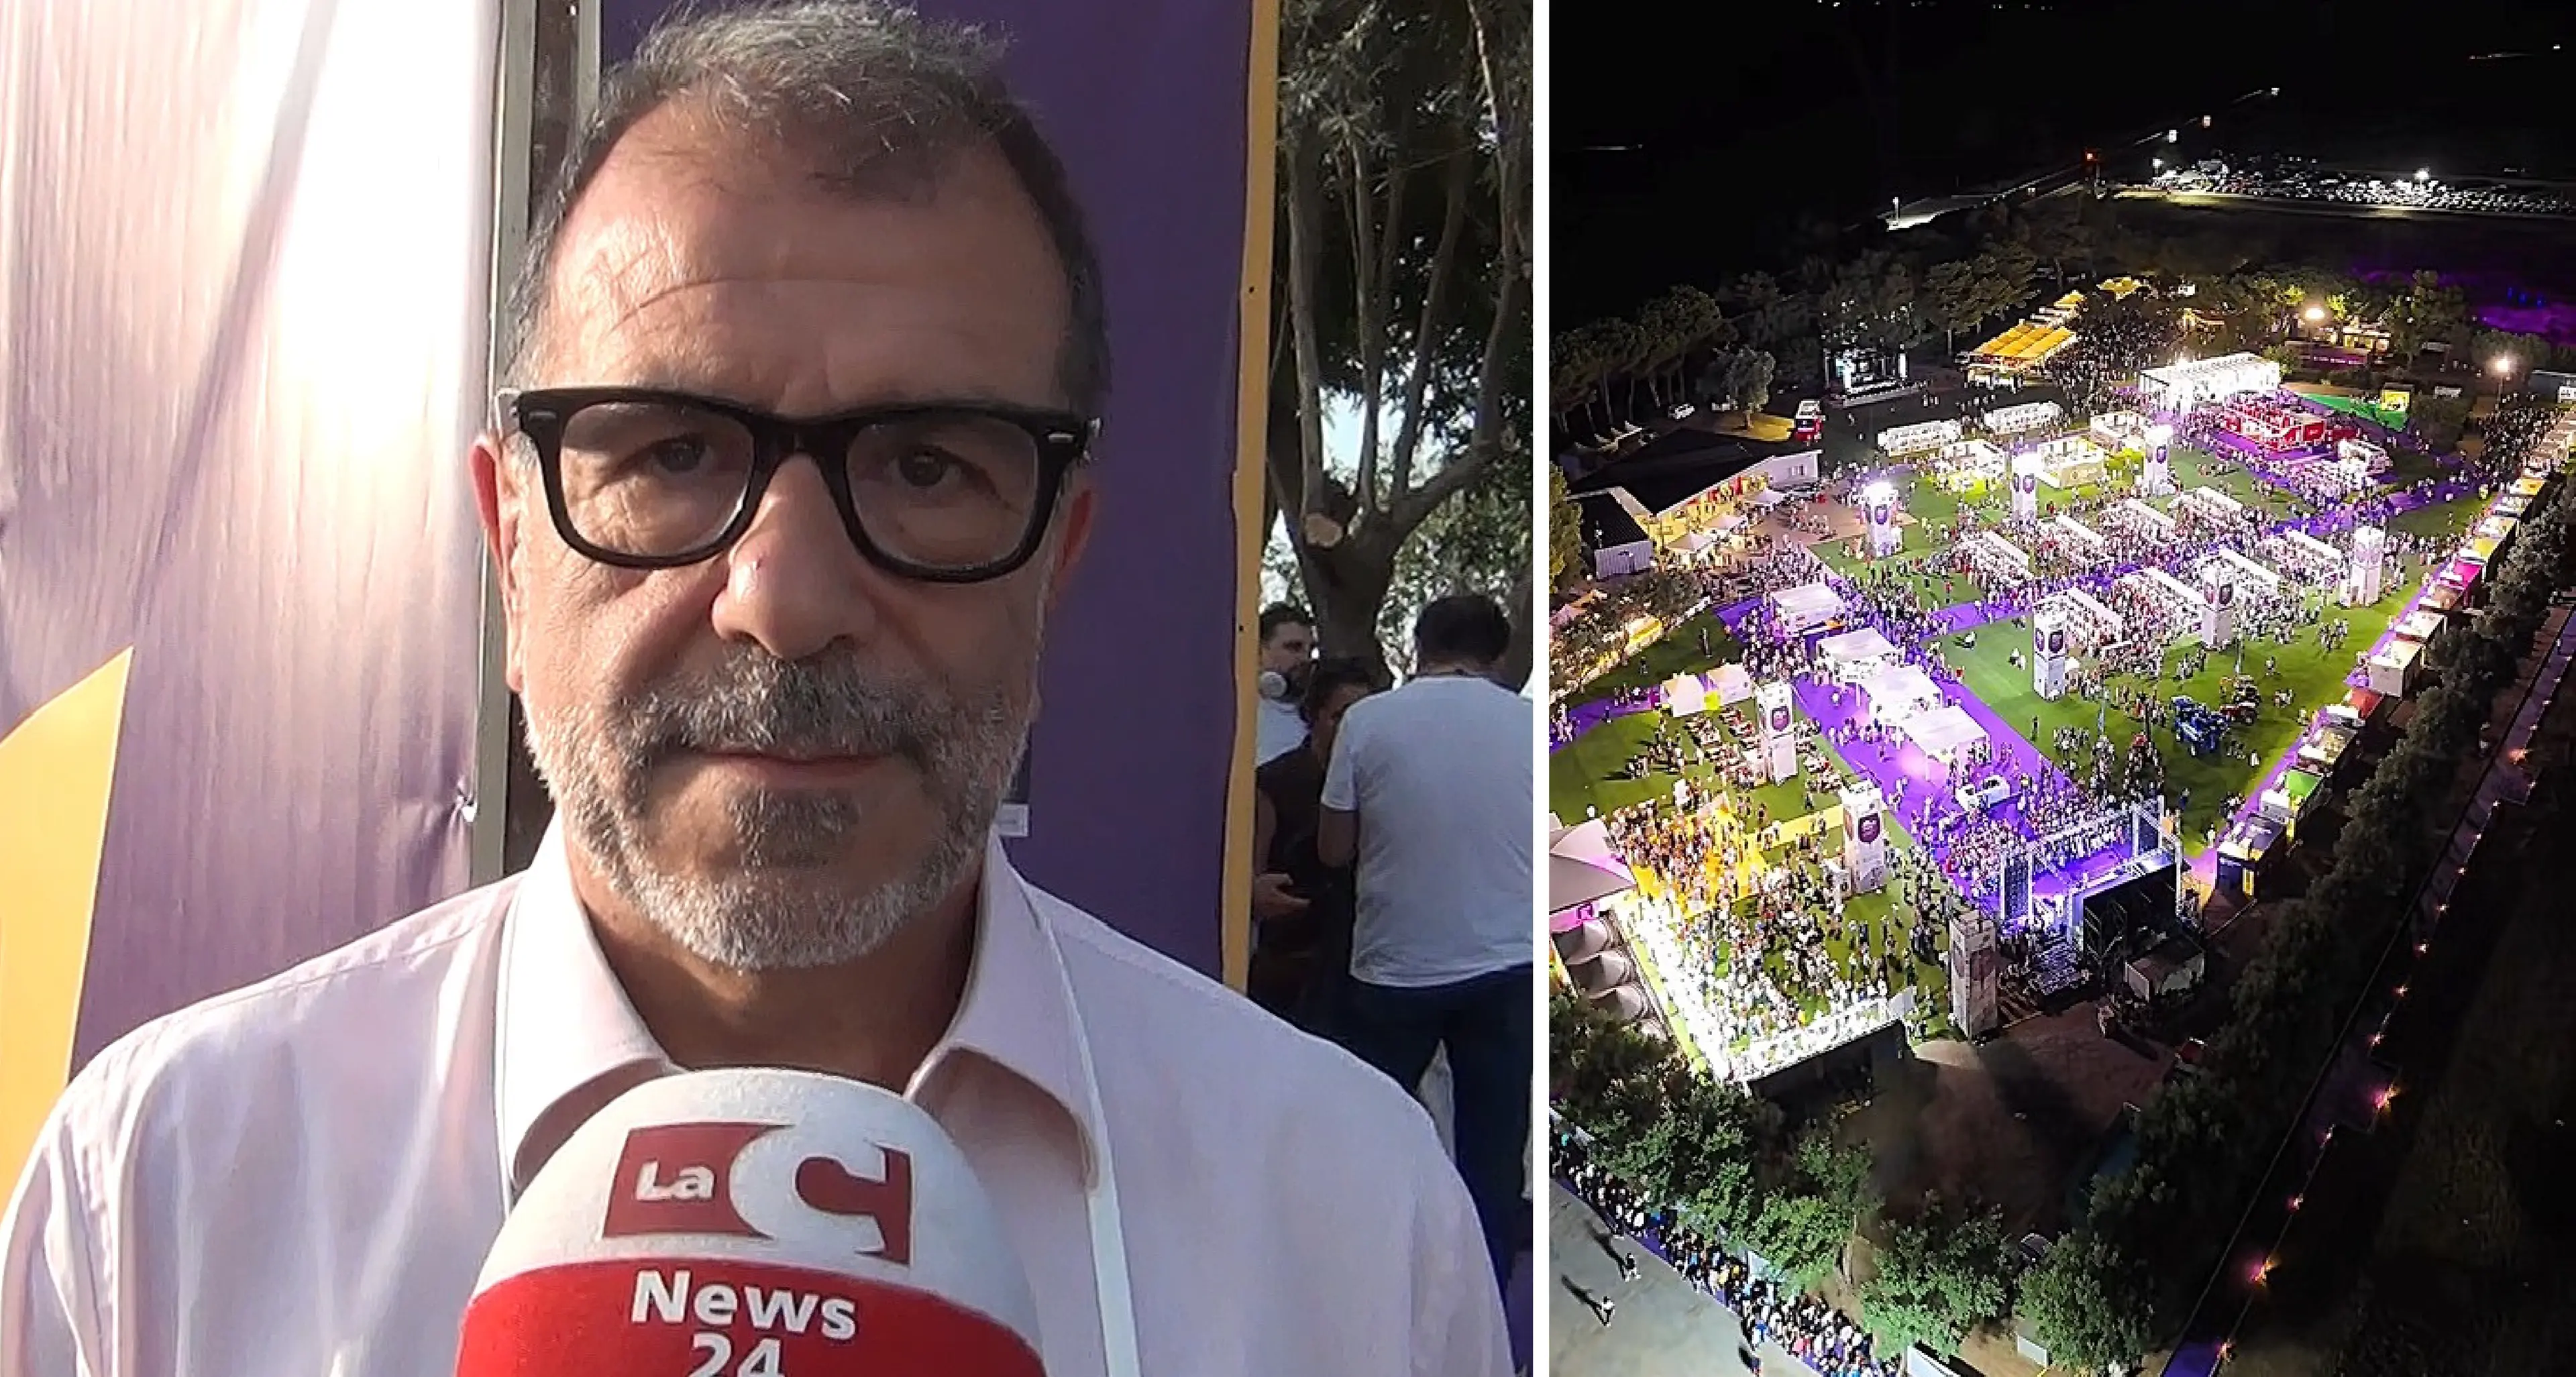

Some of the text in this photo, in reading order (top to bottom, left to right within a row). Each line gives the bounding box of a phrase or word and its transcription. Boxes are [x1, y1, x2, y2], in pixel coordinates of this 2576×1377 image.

[636, 1158, 715, 1201] La
[631, 1270, 856, 1339] News
[688, 1333, 786, 1377] 24
